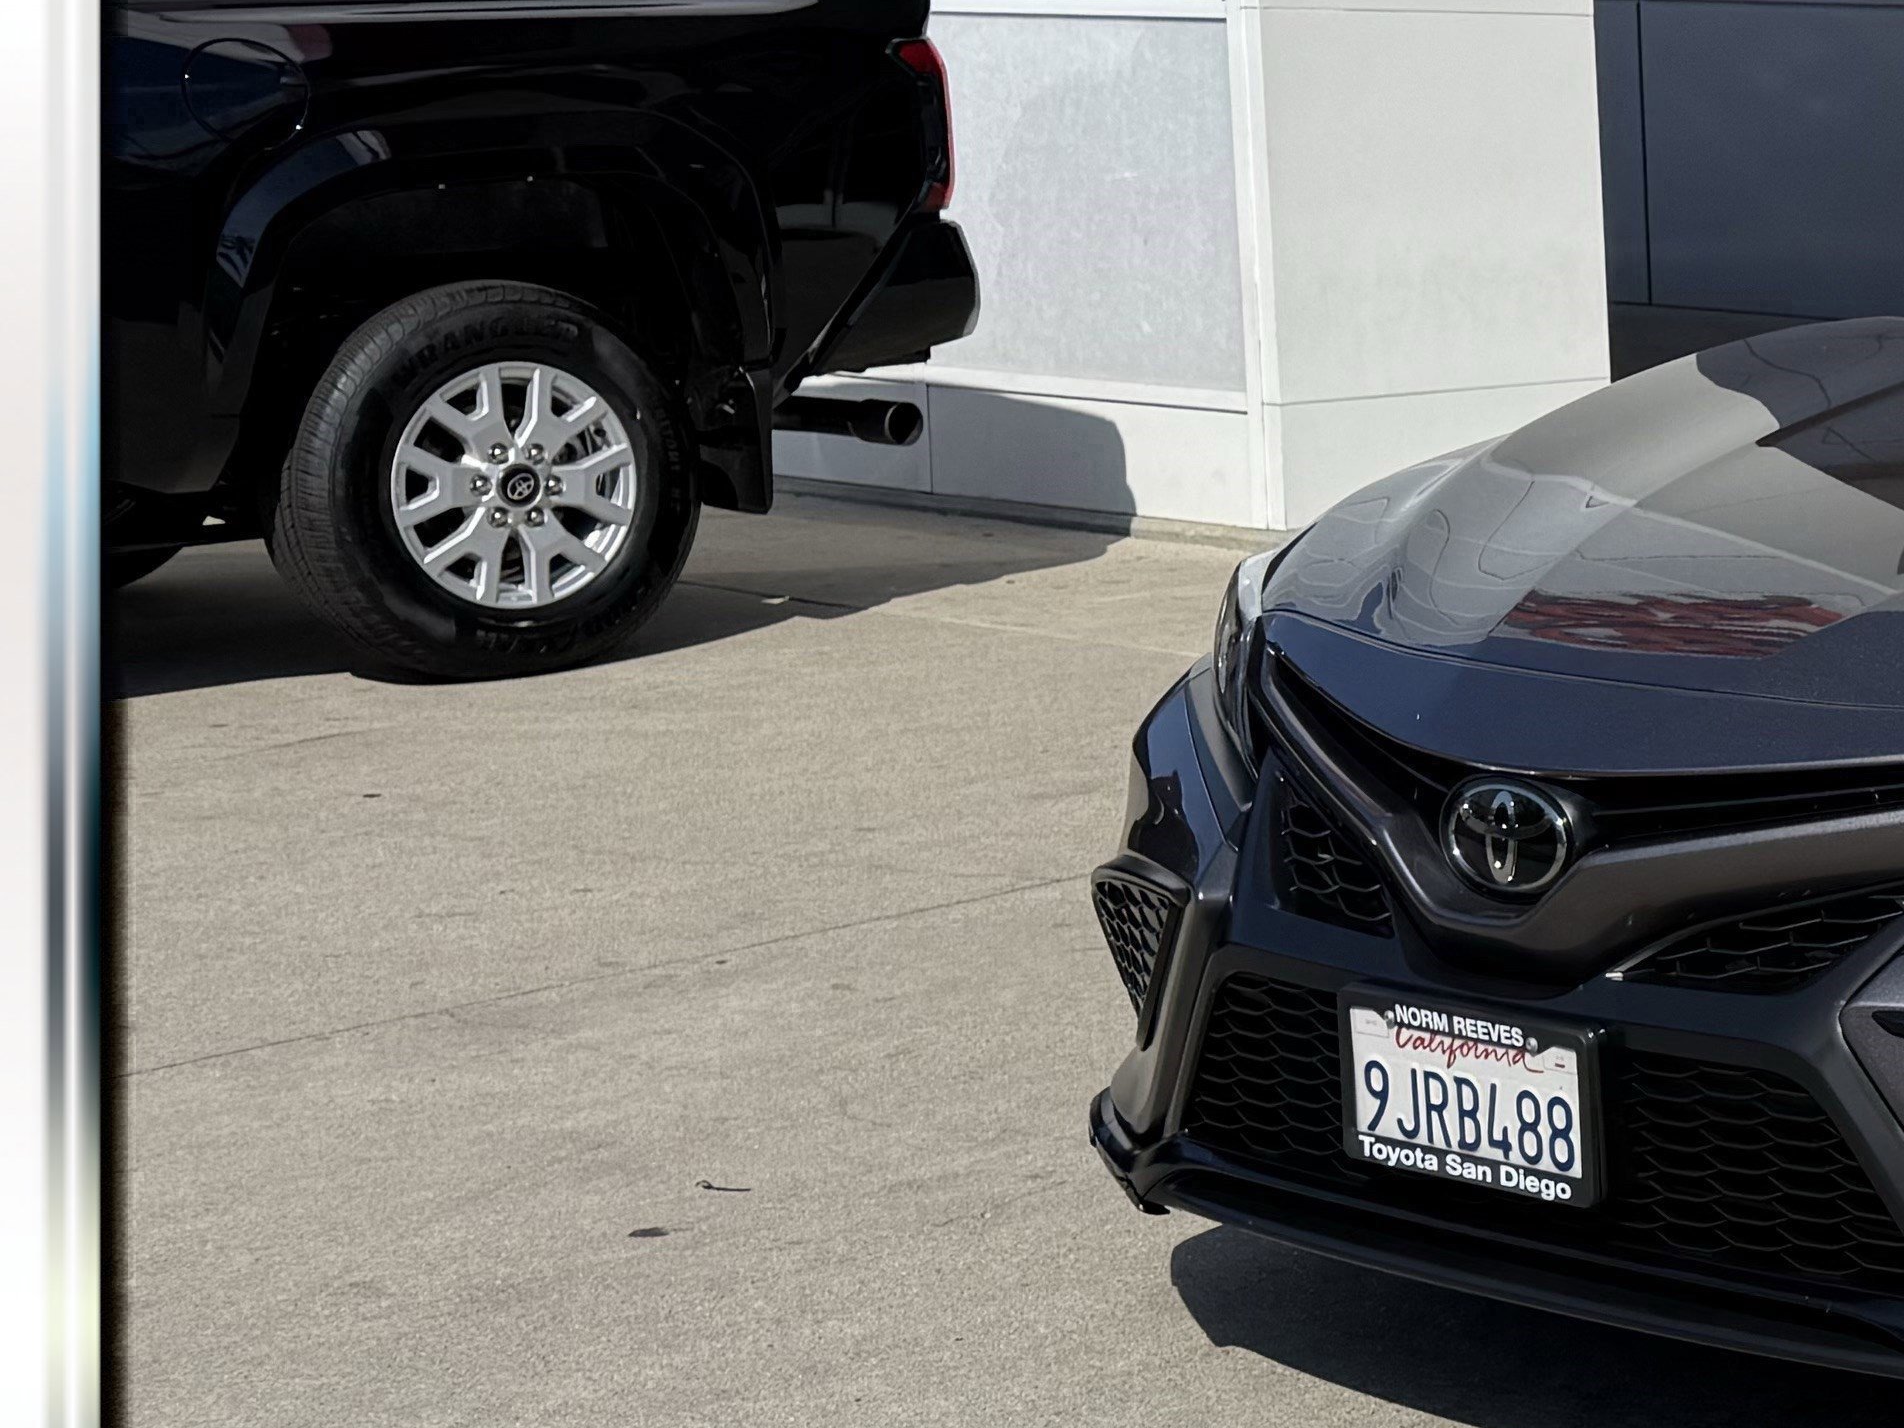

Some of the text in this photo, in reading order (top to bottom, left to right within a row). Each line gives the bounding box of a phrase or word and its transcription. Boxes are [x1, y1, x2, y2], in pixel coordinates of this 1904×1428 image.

[1394, 1004, 1524, 1048] NORM REEVES
[1395, 1027, 1544, 1074] California
[1364, 1059, 1575, 1172] 9JRB488
[1358, 1134, 1573, 1201] Toyota San Diego
